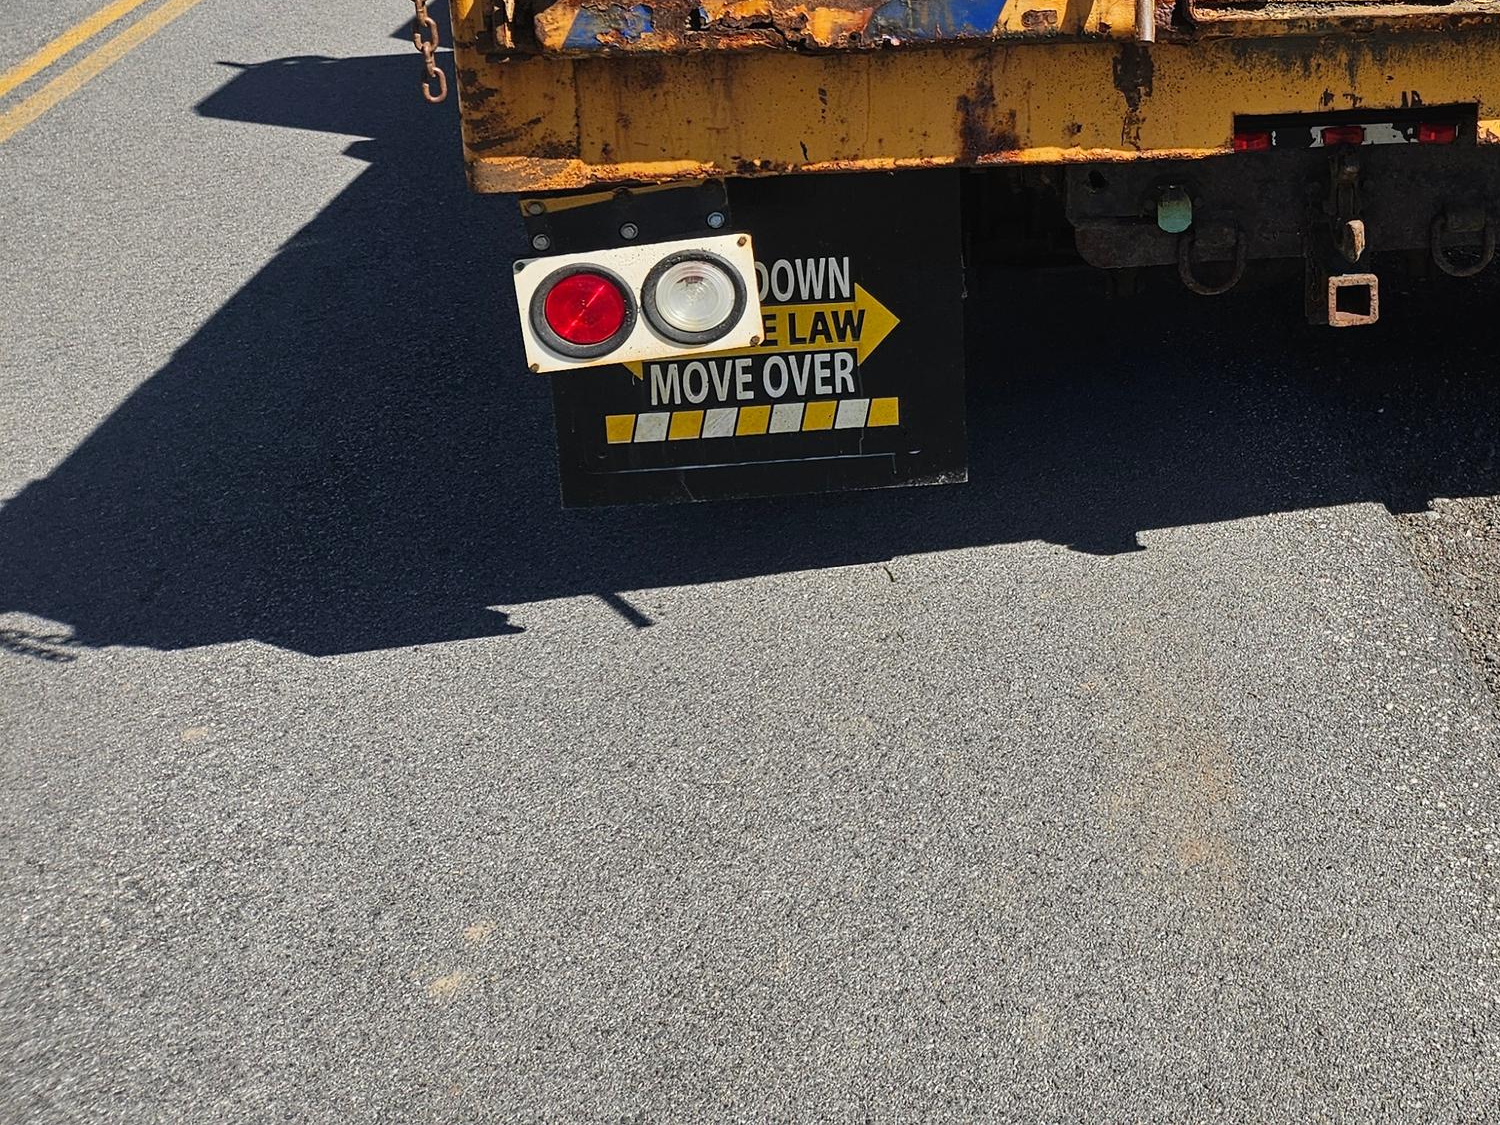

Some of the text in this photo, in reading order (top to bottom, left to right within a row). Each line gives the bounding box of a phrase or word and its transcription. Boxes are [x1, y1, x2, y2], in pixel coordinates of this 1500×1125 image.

[788, 309, 865, 345] LAW
[651, 352, 855, 406] MOVE OVER
